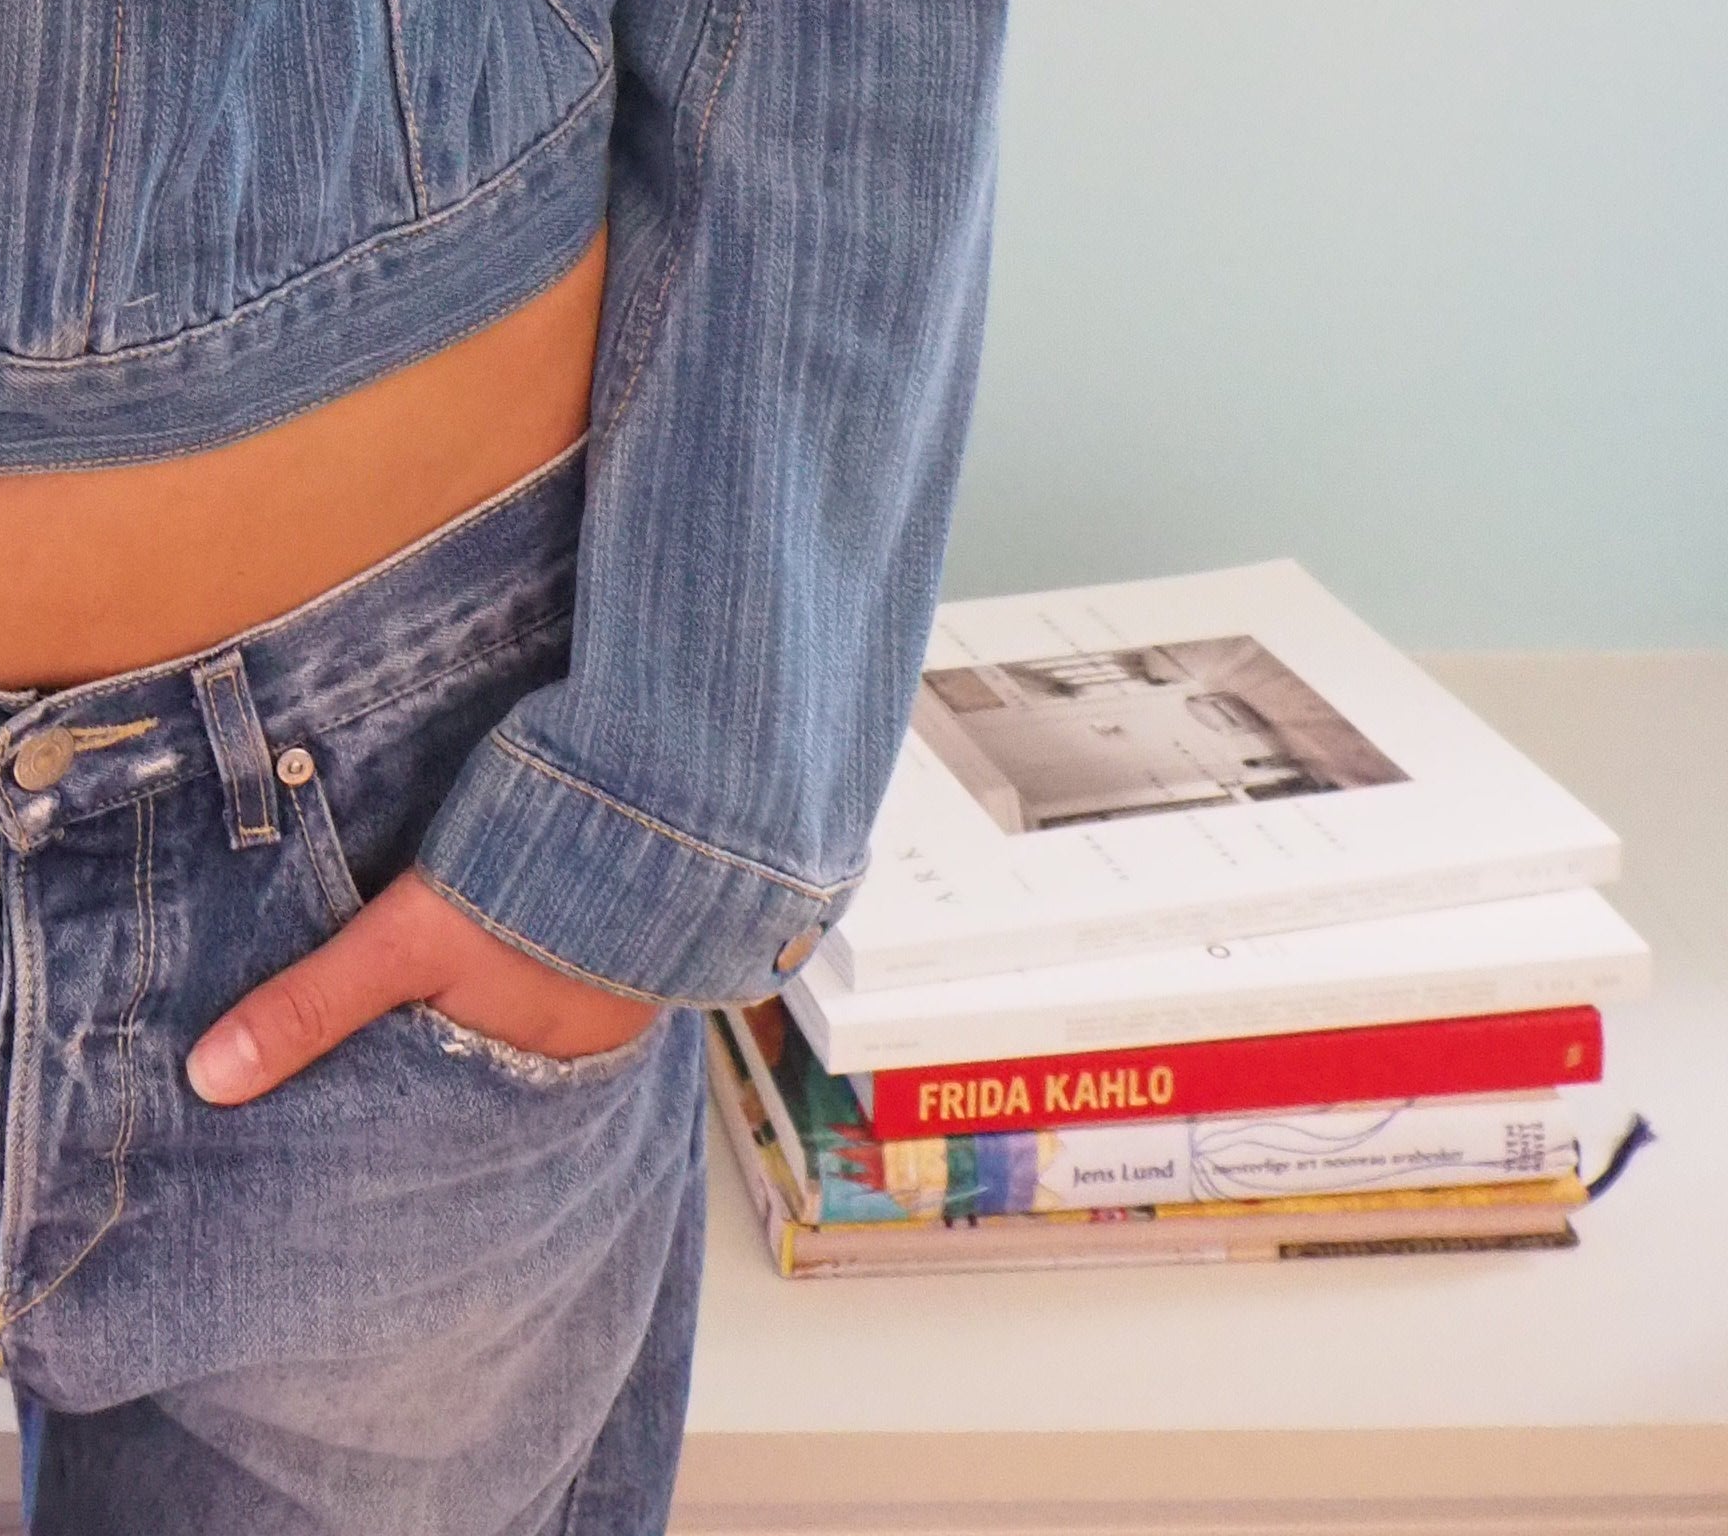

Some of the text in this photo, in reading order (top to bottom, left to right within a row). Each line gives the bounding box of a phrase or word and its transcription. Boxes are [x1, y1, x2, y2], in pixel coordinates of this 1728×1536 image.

[919, 1066, 1174, 1120] FRIDA KAHLO
[1073, 1159, 1174, 1187] Jens Lund
